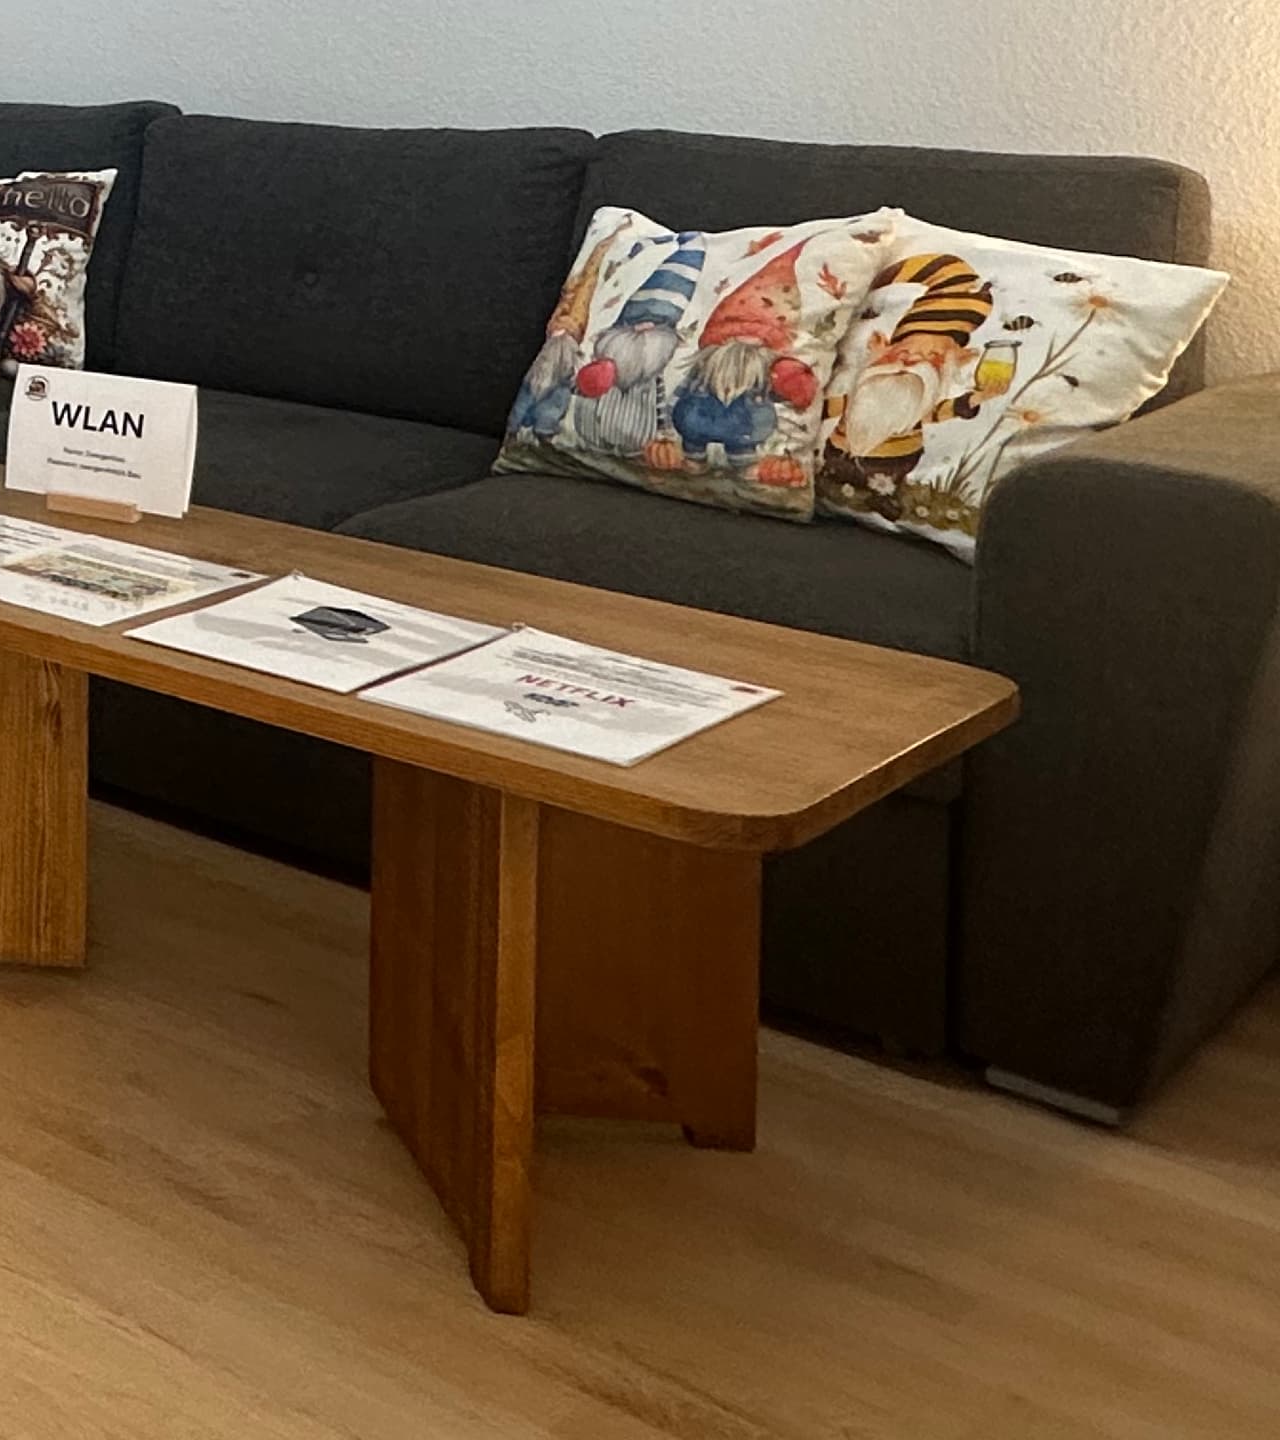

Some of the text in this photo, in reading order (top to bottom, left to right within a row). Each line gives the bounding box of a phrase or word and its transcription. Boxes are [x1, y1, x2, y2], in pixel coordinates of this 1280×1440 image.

[3, 186, 90, 217] hello
[51, 400, 145, 439] WLAN
[516, 673, 637, 709] NETFLIX
